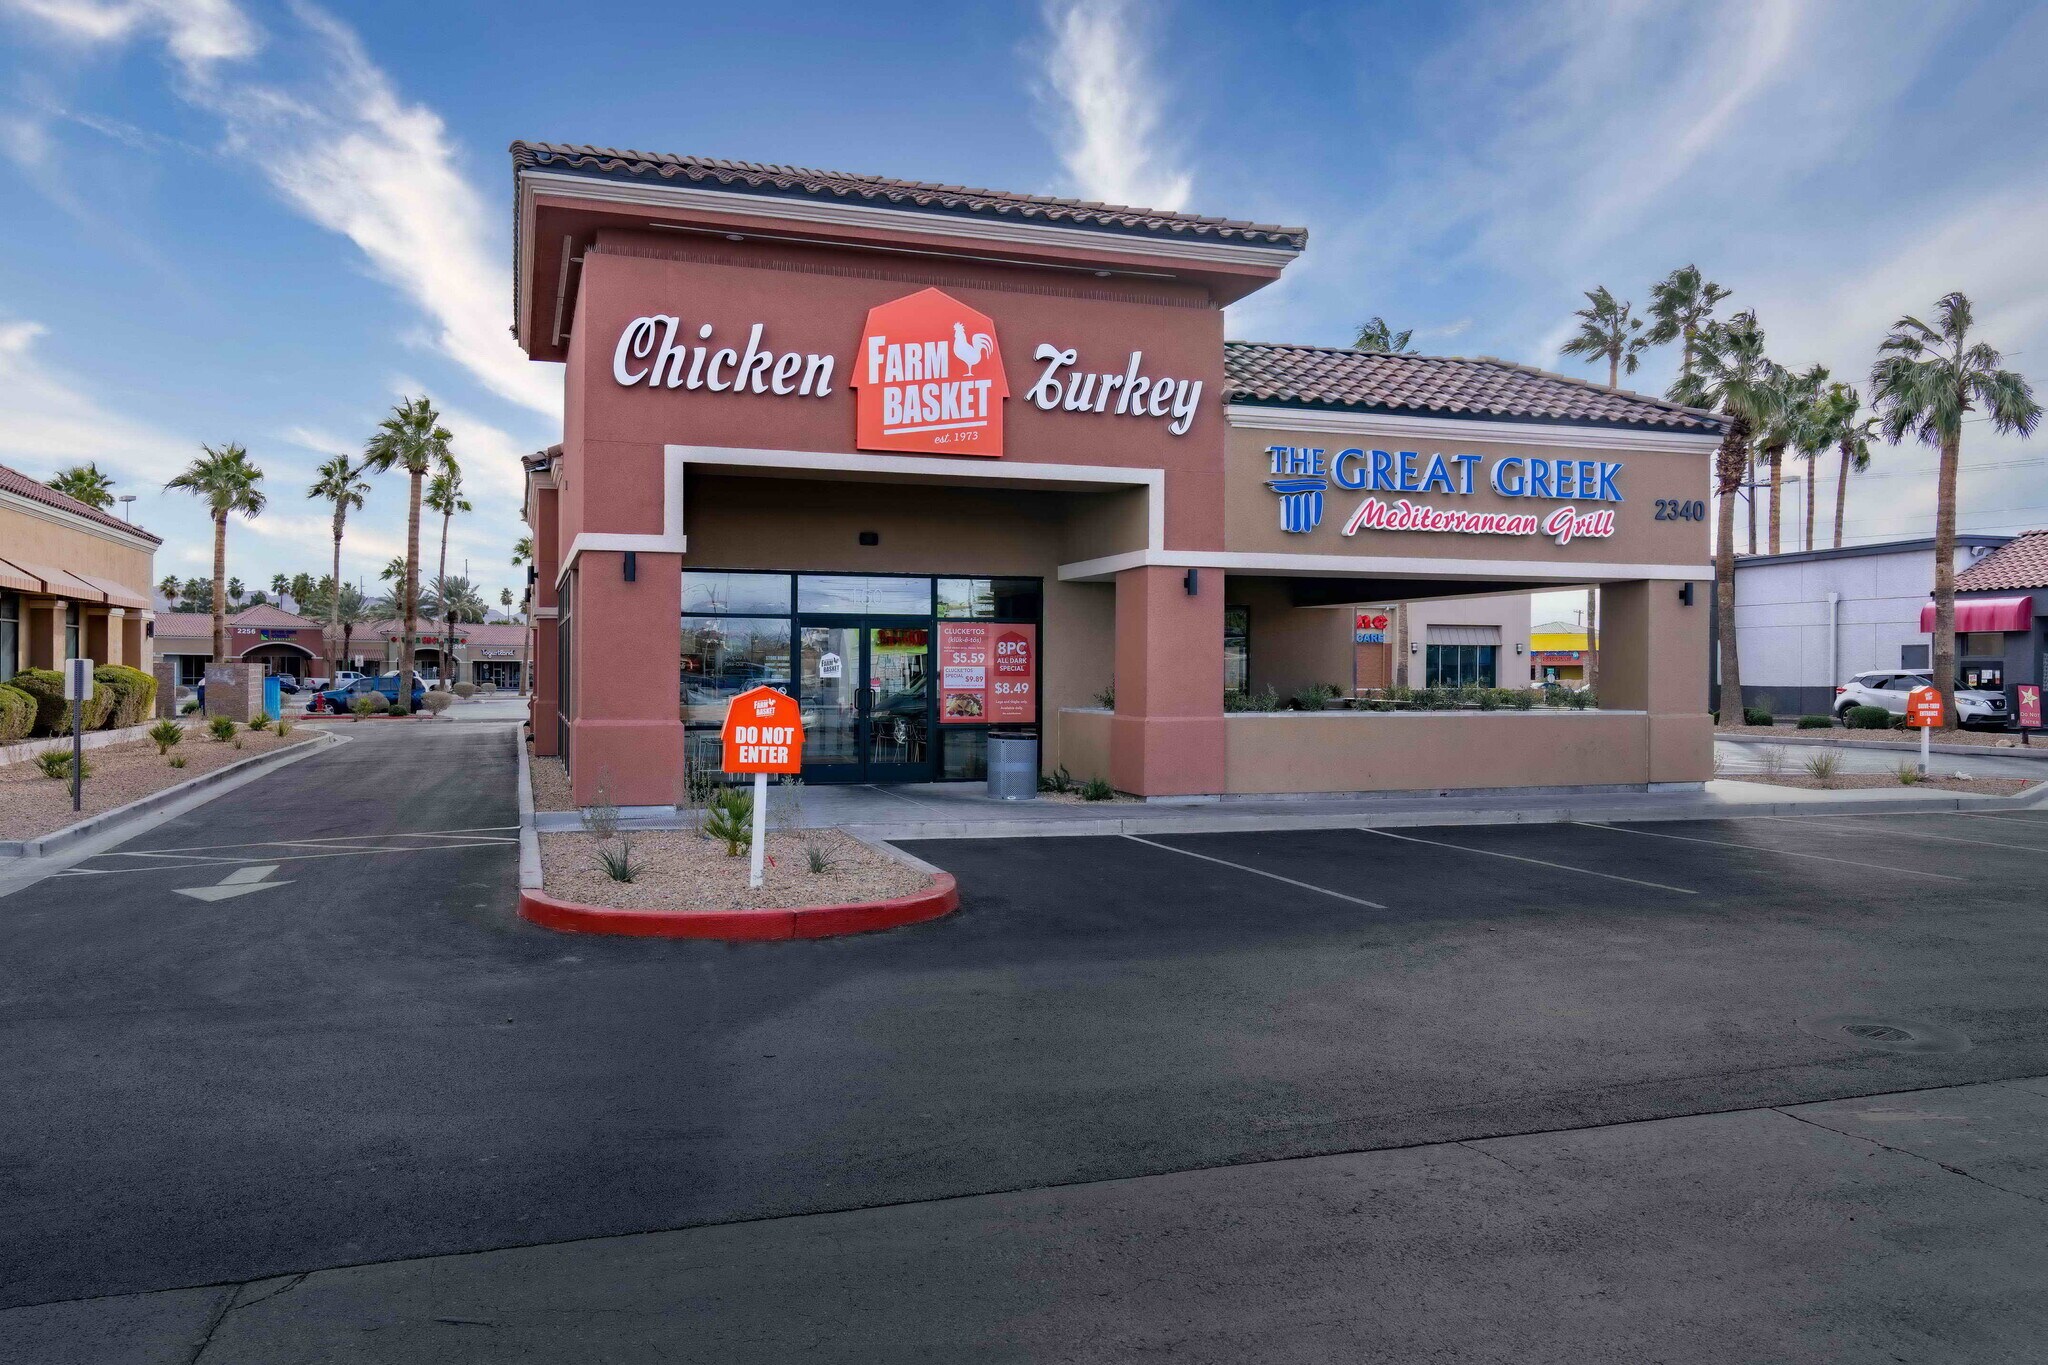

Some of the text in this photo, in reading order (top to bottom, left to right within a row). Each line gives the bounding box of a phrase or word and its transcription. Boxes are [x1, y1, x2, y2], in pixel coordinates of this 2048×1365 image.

[613, 314, 835, 398] Chicken
[868, 335, 949, 385] FARM
[1023, 343, 1203, 436] Turkey
[883, 379, 992, 426] BASKET
[934, 431, 979, 444] est. 1973
[1265, 445, 1624, 502] THE GREAT GREEK
[1654, 500, 1704, 522] 2340
[1341, 497, 1615, 545] Mediterranean Grill
[1356, 632, 1384, 643] CARE
[953, 652, 985, 663] $5.59
[997, 641, 1027, 655] 8PC
[965, 675, 984, 683] $9.89
[995, 682, 1029, 694] $8.49
[735, 726, 794, 745] DO NOT
[739, 746, 789, 764] ENTER
